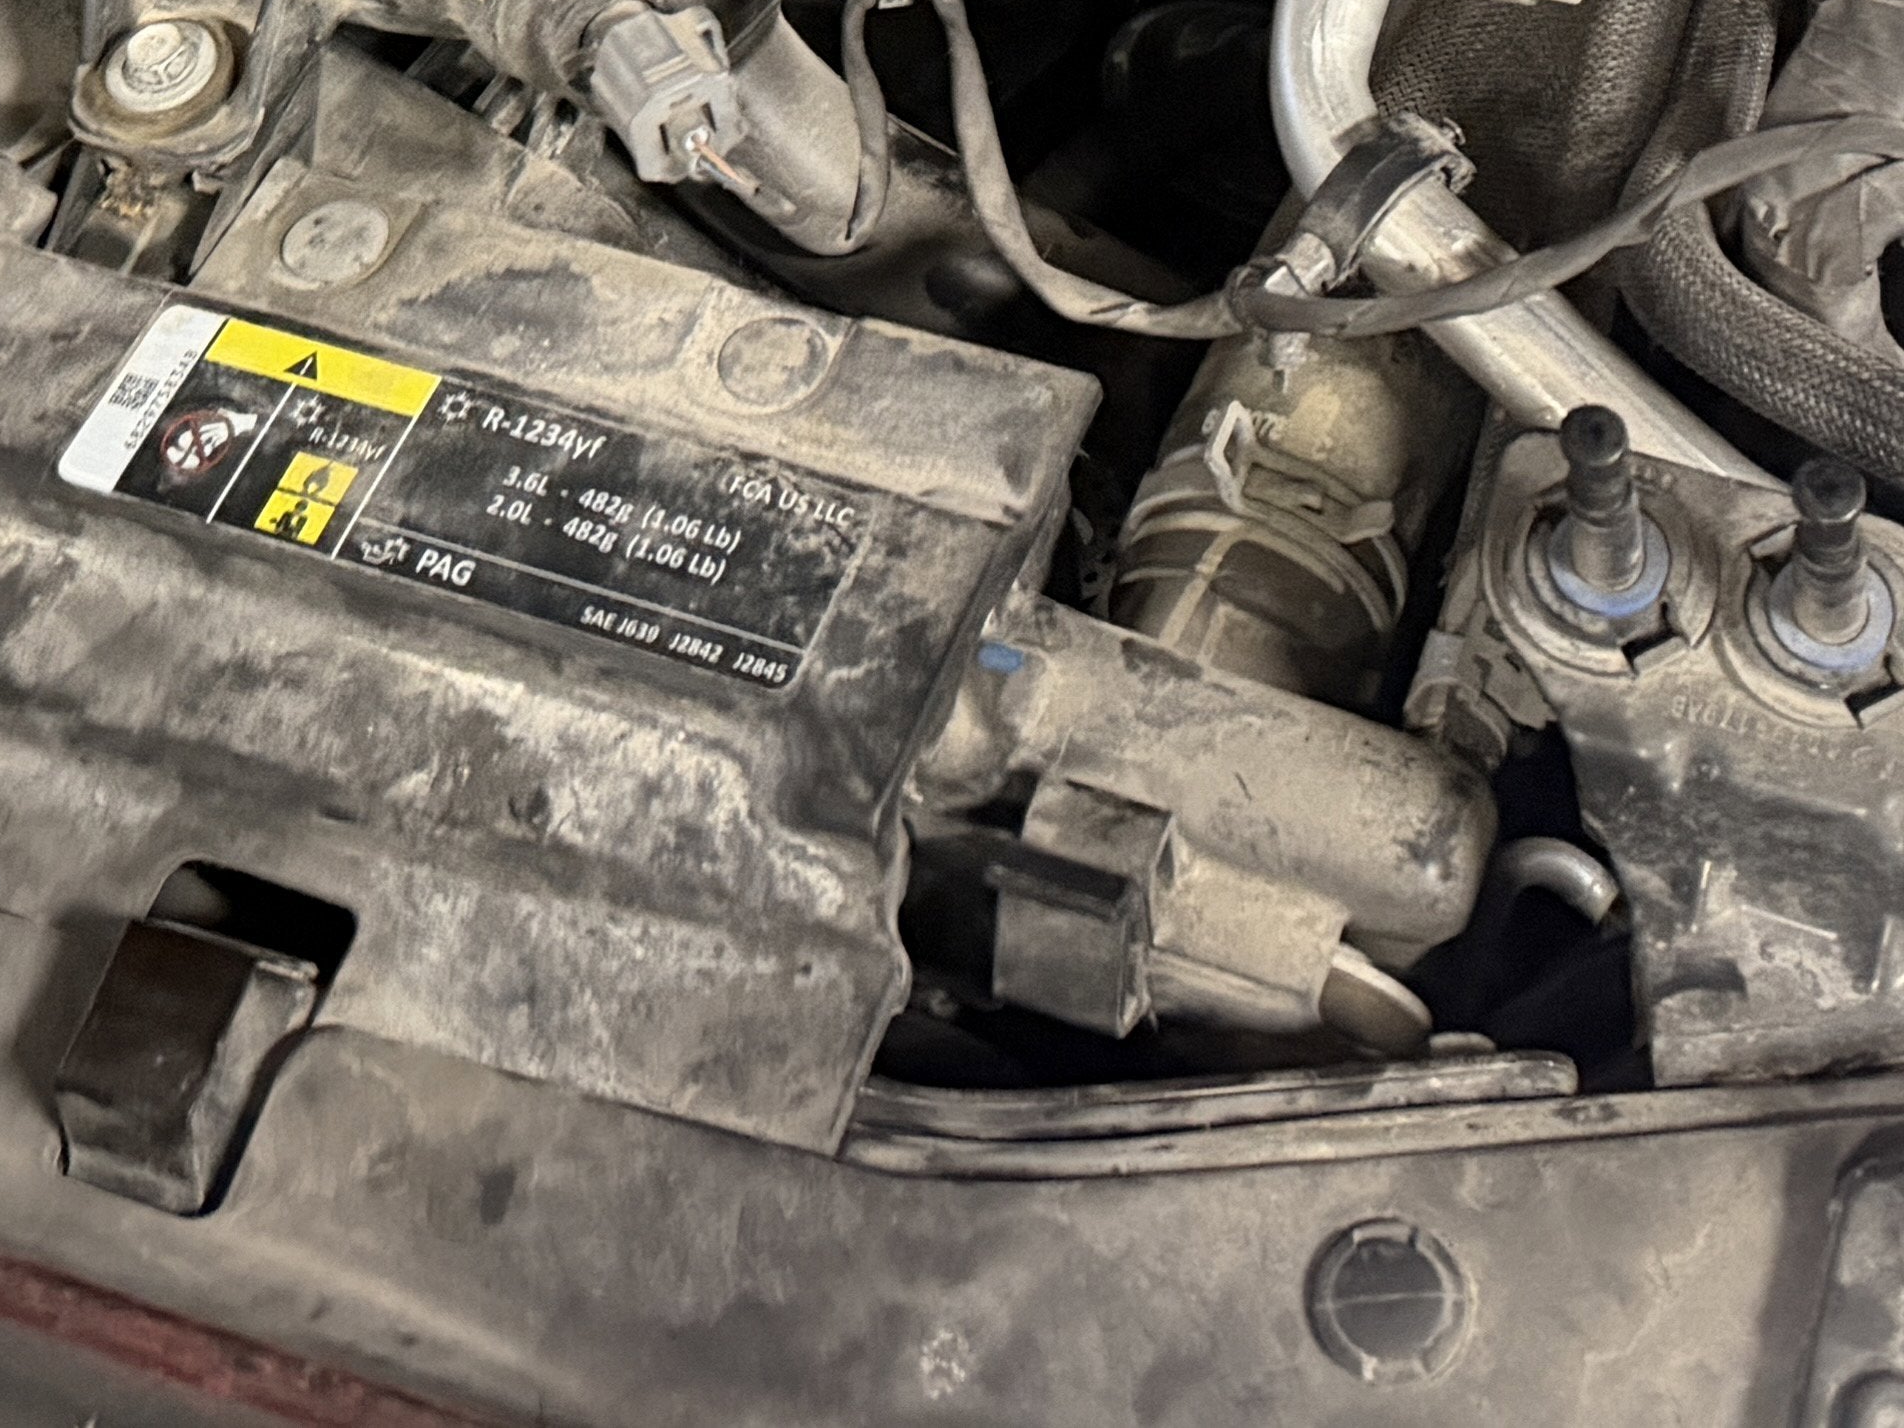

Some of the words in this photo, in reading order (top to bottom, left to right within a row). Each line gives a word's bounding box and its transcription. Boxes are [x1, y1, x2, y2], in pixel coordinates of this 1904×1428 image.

[483, 406, 607, 460] R-1234yf
[502, 466, 549, 497] 3.6L
[578, 487, 634, 524] 482g
[641, 504, 700, 540] (1.06
[703, 523, 743, 556] Lb)
[728, 475, 772, 505] FCA
[778, 489, 811, 515] US
[813, 500, 856, 528] LLC
[415, 548, 477, 587] PAG
[486, 494, 533, 526] 2.0L
[562, 516, 618, 553] 482g
[625, 535, 684, 569] (1.06
[687, 554, 728, 587] Lb)
[579, 605, 617, 632] SAE
[668, 632, 724, 664] J2842
[732, 651, 789, 683] J2845
